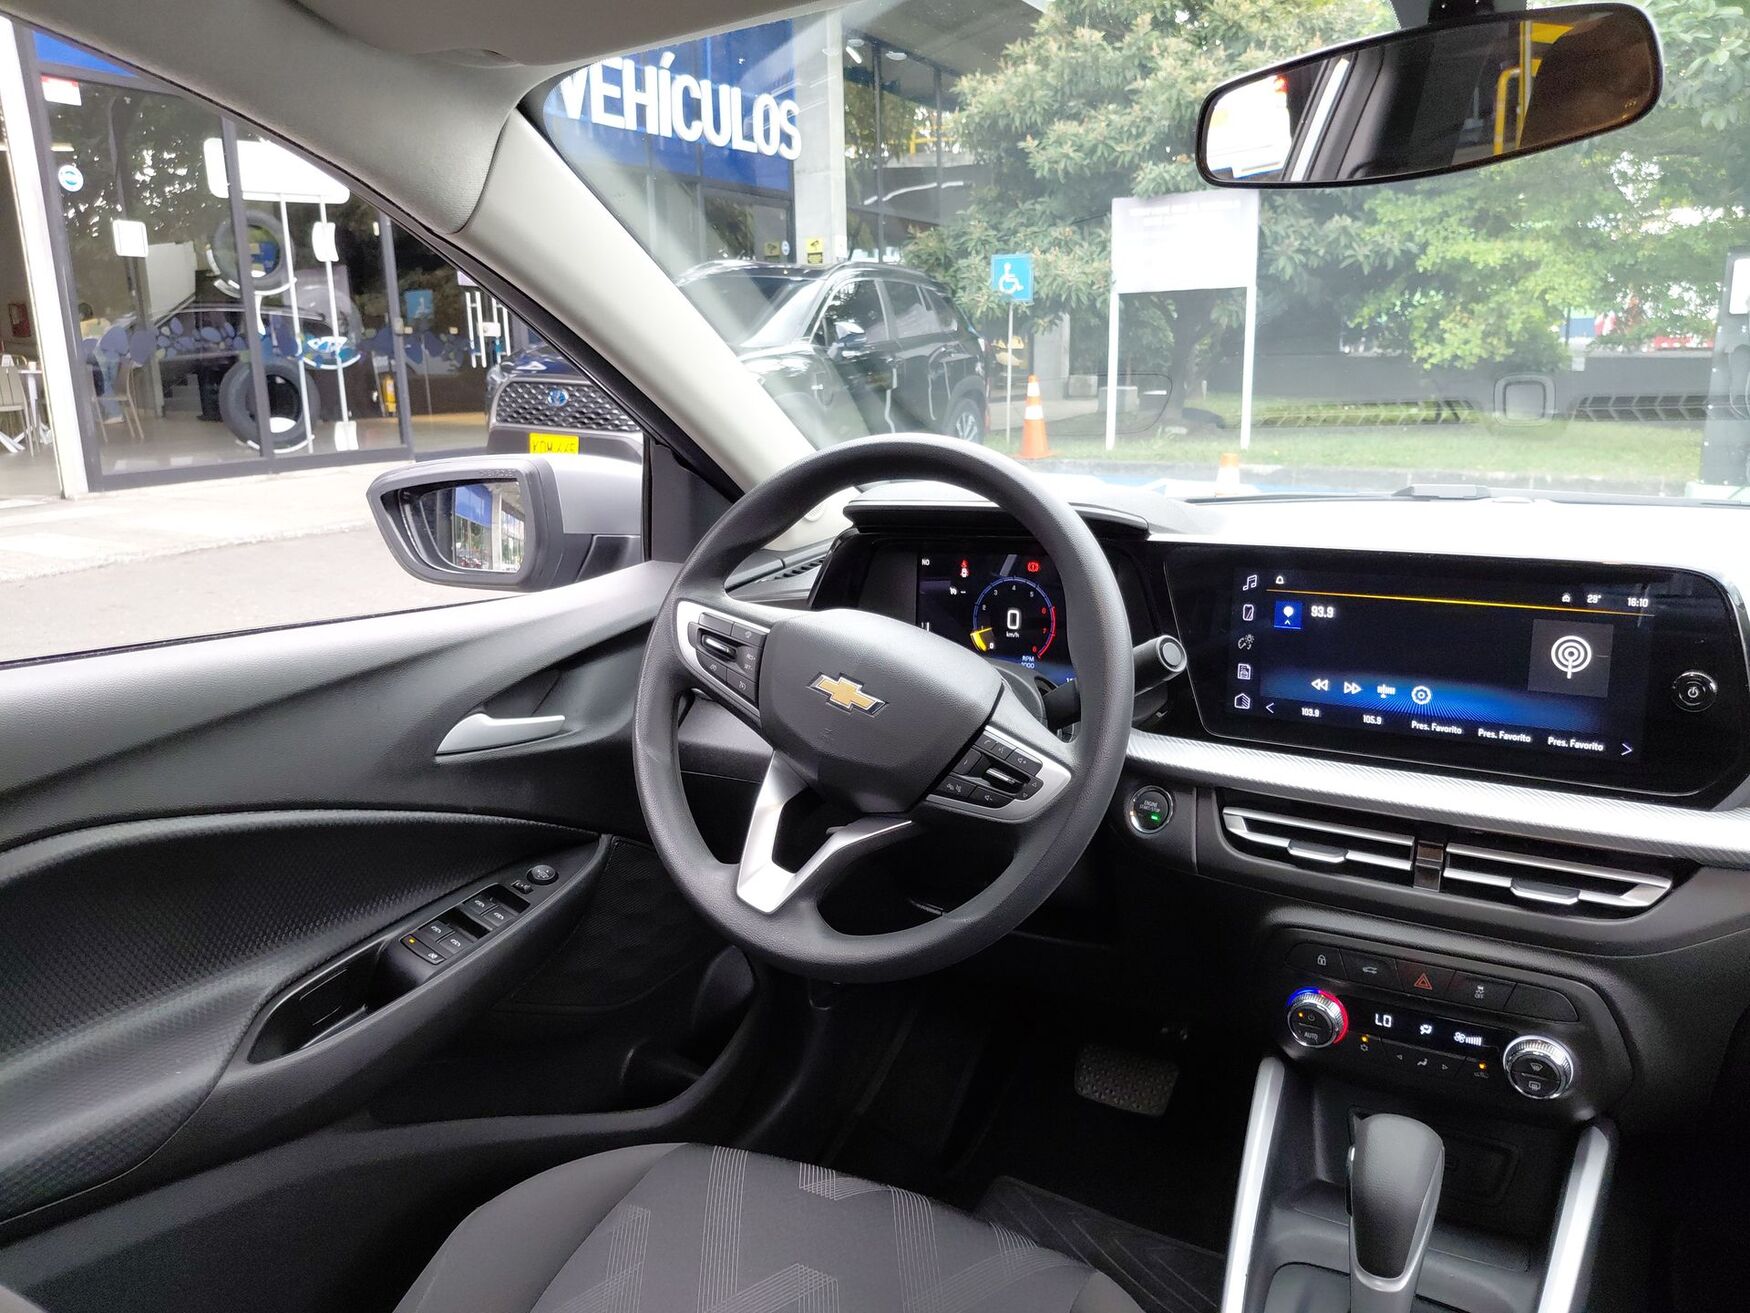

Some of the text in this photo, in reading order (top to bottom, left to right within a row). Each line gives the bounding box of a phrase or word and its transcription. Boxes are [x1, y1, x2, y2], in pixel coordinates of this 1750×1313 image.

[559, 51, 801, 160] VEHÍCULOS
[1311, 605, 1334, 618] 93.9
[1007, 609, 1020, 630] 0
[1301, 707, 1320, 717] 103.9
[1411, 720, 1463, 735] Pres. Favorito
[1477, 728, 1531, 743] Pres. Favorito
[1547, 736, 1604, 752] Pres. Favorito
